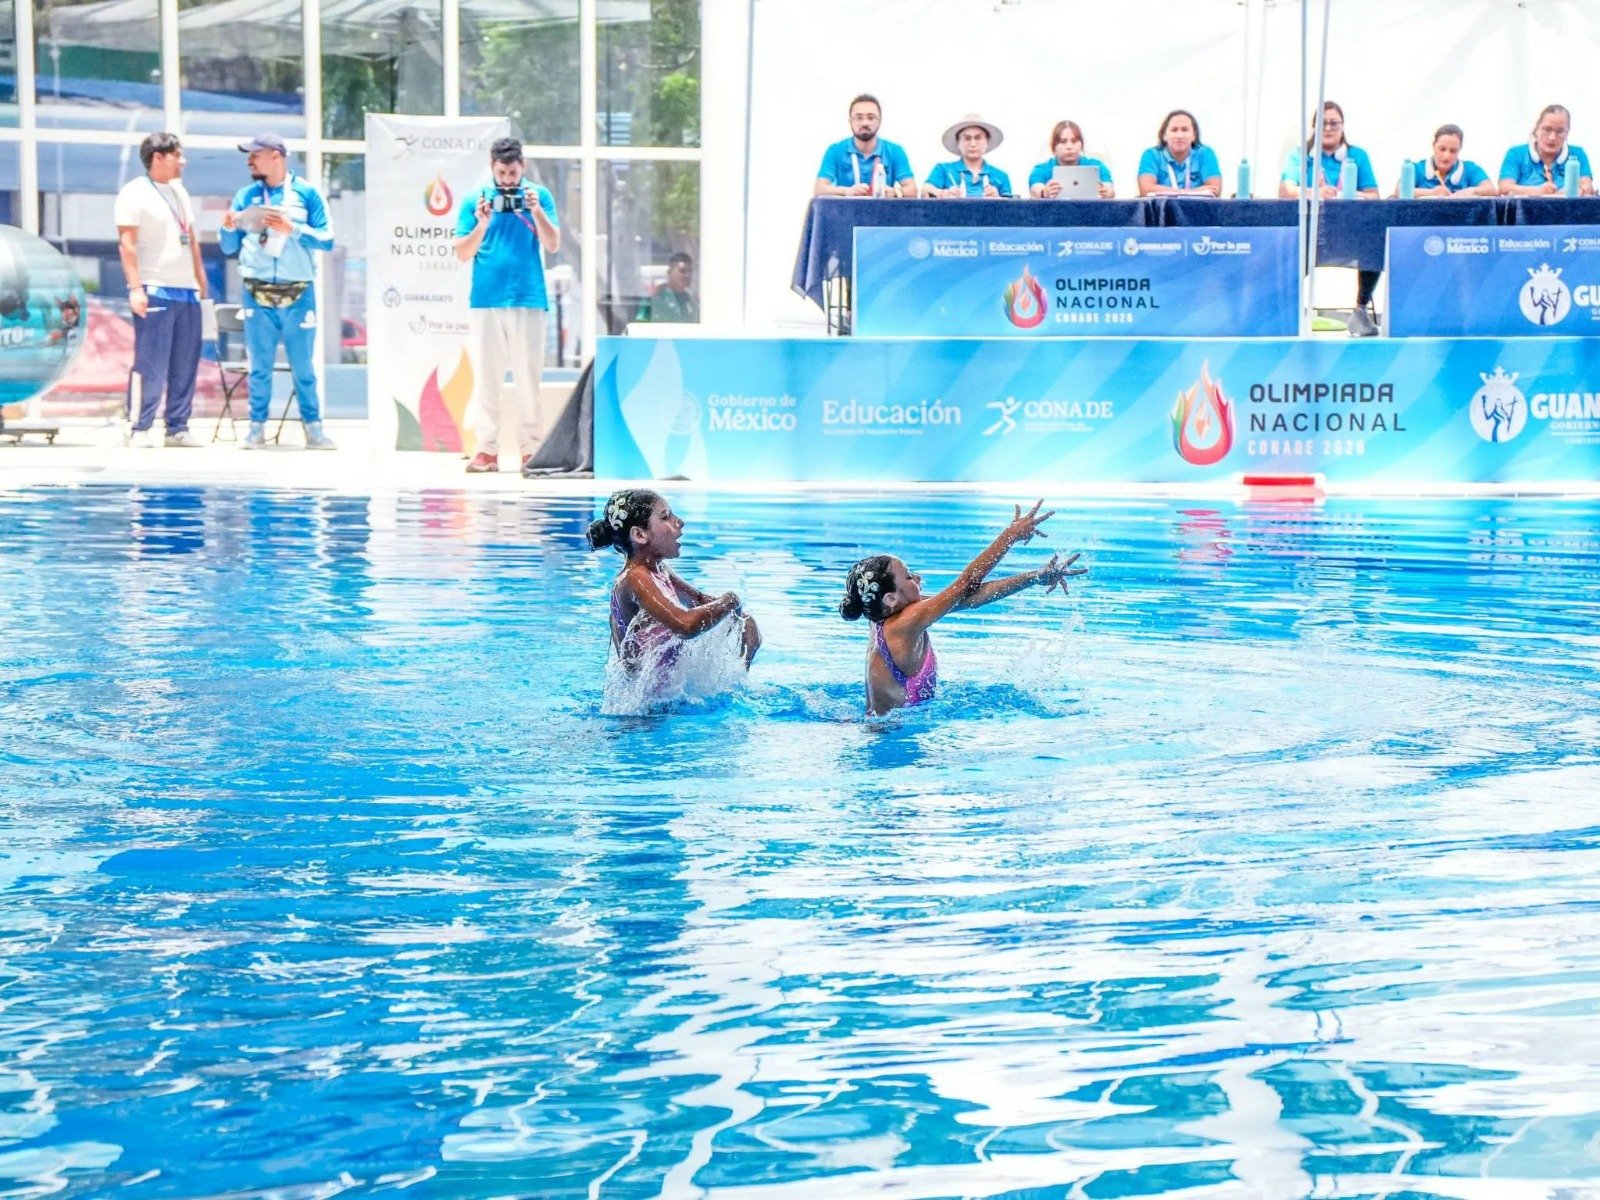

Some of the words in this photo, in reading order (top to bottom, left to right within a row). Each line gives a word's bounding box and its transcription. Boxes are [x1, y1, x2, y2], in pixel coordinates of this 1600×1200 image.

[422, 137, 487, 150] CONADE
[394, 227, 456, 239] OLIMPIA
[989, 241, 1044, 252] Educación
[1075, 242, 1113, 250] CONADE
[1447, 243, 1489, 254] México
[1499, 238, 1549, 248] Educación
[391, 244, 455, 257] NACIO
[933, 245, 978, 257] México
[1055, 278, 1151, 291] OLIMPIADA
[1056, 296, 1160, 309] NACIONAL
[1250, 383, 1394, 403] OLIMPIADA
[707, 394, 777, 407] Gobierno
[780, 394, 797, 406] de
[1530, 393, 1600, 419] GUAN
[822, 398, 962, 425] Educación
[1024, 401, 1114, 418] CONADE
[708, 407, 797, 431] México
[1250, 413, 1406, 432] NACIONAL
[1248, 440, 1314, 456] CONADE
